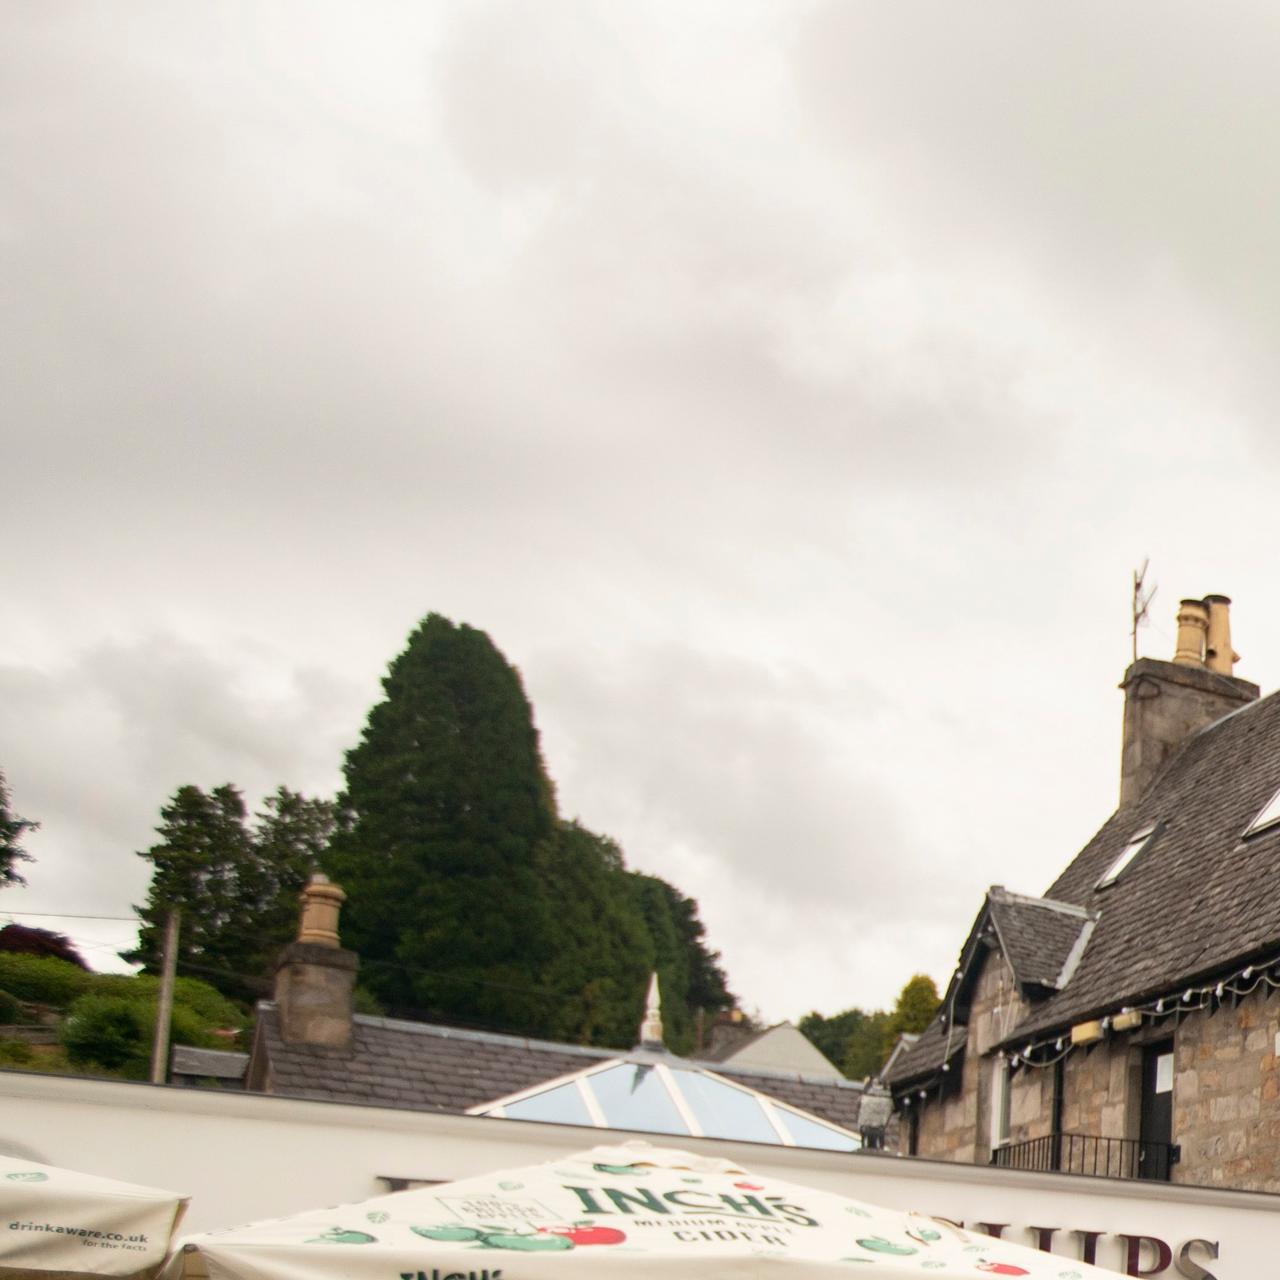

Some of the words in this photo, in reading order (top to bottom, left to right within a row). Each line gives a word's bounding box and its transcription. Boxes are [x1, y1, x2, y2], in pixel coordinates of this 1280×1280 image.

[634, 1219, 726, 1227] MEDIUM
[9, 1221, 149, 1243] drinkaware.co.uk
[673, 1230, 787, 1246] CIDER
[83, 1239, 97, 1247] for
[100, 1241, 118, 1249] the
[121, 1243, 147, 1251] facts
